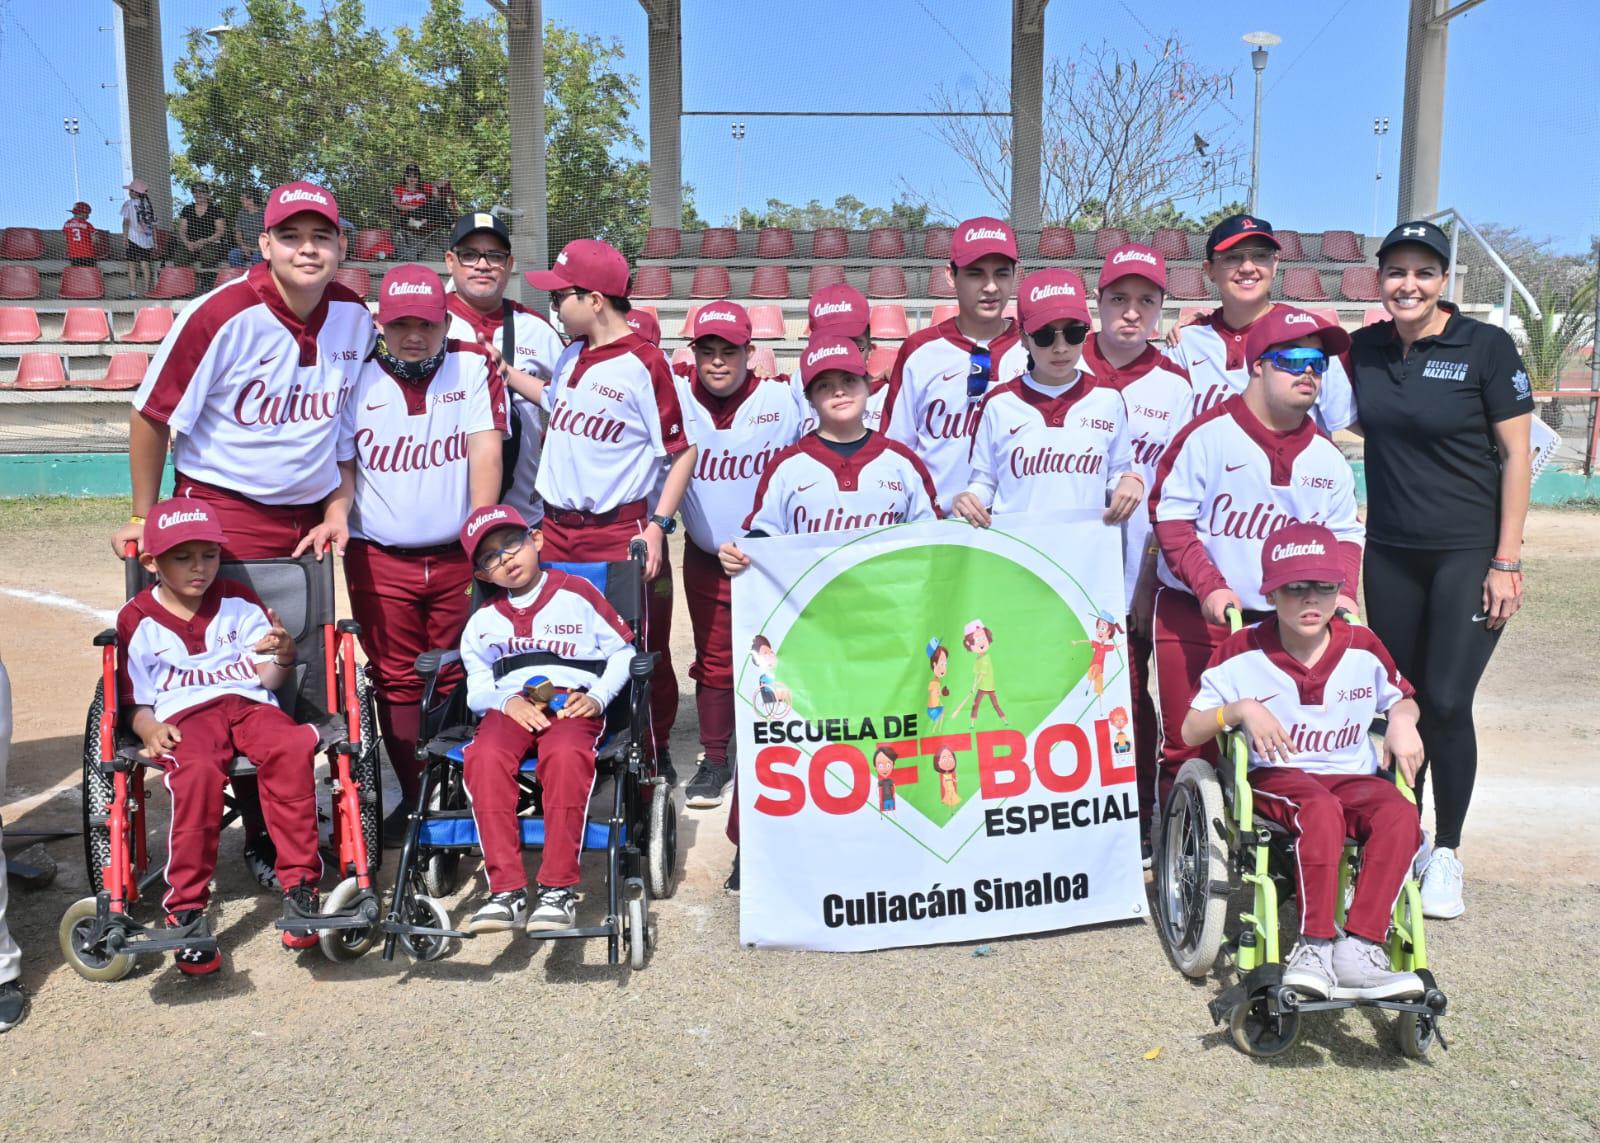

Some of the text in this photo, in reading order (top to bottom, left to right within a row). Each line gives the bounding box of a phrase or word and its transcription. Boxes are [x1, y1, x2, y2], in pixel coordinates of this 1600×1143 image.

[280, 189, 328, 206] Culiacán
[72, 228, 81, 241] 3
[965, 228, 1007, 243] Culiacán
[1113, 251, 1157, 266] Culiacán
[389, 280, 433, 296] Culiacán
[1030, 282, 1076, 302] Culiacán
[699, 307, 737, 323] Culiacán
[814, 300, 852, 317] Culiacán
[1284, 313, 1320, 329] Culia
[516, 346, 537, 357] ISDE
[807, 346, 849, 366] Culiacán
[1422, 367, 1466, 382] MAZATLÁN
[443, 390, 467, 403] ISDE
[600, 386, 625, 402] ISDE
[757, 412, 780, 425] ISDE
[870, 410, 882, 421] IS
[1143, 407, 1170, 421] ISDE
[1090, 418, 1115, 433] ISDE
[1010, 446, 1103, 480] Culiacán
[888, 480, 903, 492] ISD
[1310, 477, 1335, 490] ISDE
[158, 508, 209, 530] Culiacán
[467, 508, 508, 537] Culiacán
[1209, 493, 1326, 541] Culia
[1271, 540, 1326, 562] Culiacán
[554, 623, 583, 635] ISDE
[1350, 686, 1373, 701] ISDE
[753, 713, 918, 745] ESCUELA DE
[1286, 718, 1361, 753] liacán
[752, 717, 1137, 818] SOFTBOL
[984, 792, 1139, 838] ESPECIAL
[822, 872, 1090, 929] Culiacán Sinaloa
